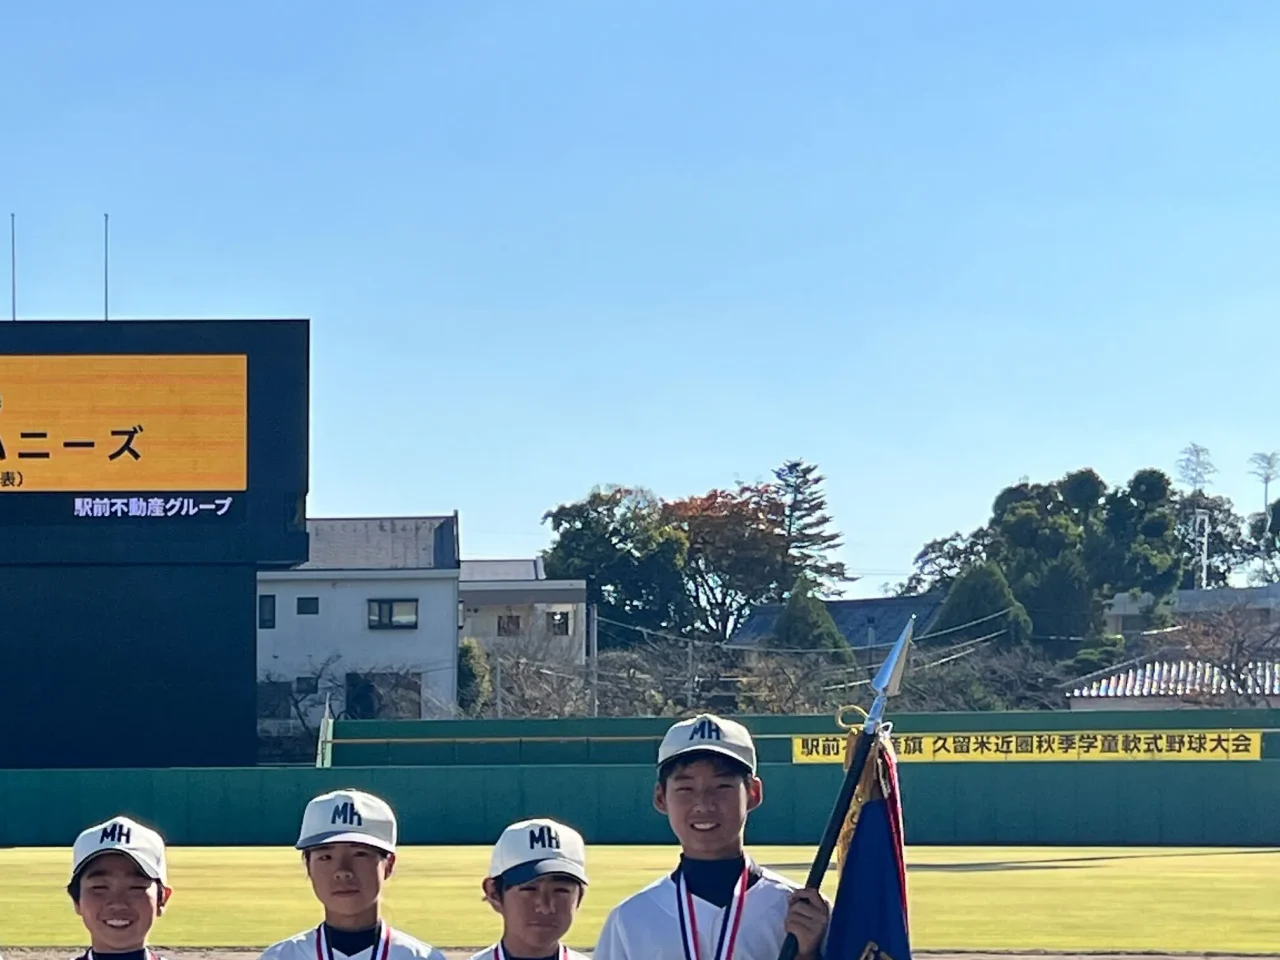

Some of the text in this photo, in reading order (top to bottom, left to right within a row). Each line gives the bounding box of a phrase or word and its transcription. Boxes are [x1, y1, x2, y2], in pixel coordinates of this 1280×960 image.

[74, 497, 233, 517] 駅前不動産グループ
[689, 719, 721, 741] MH
[331, 802, 362, 826] MH
[100, 822, 131, 844] MH
[529, 826, 560, 849] MH
